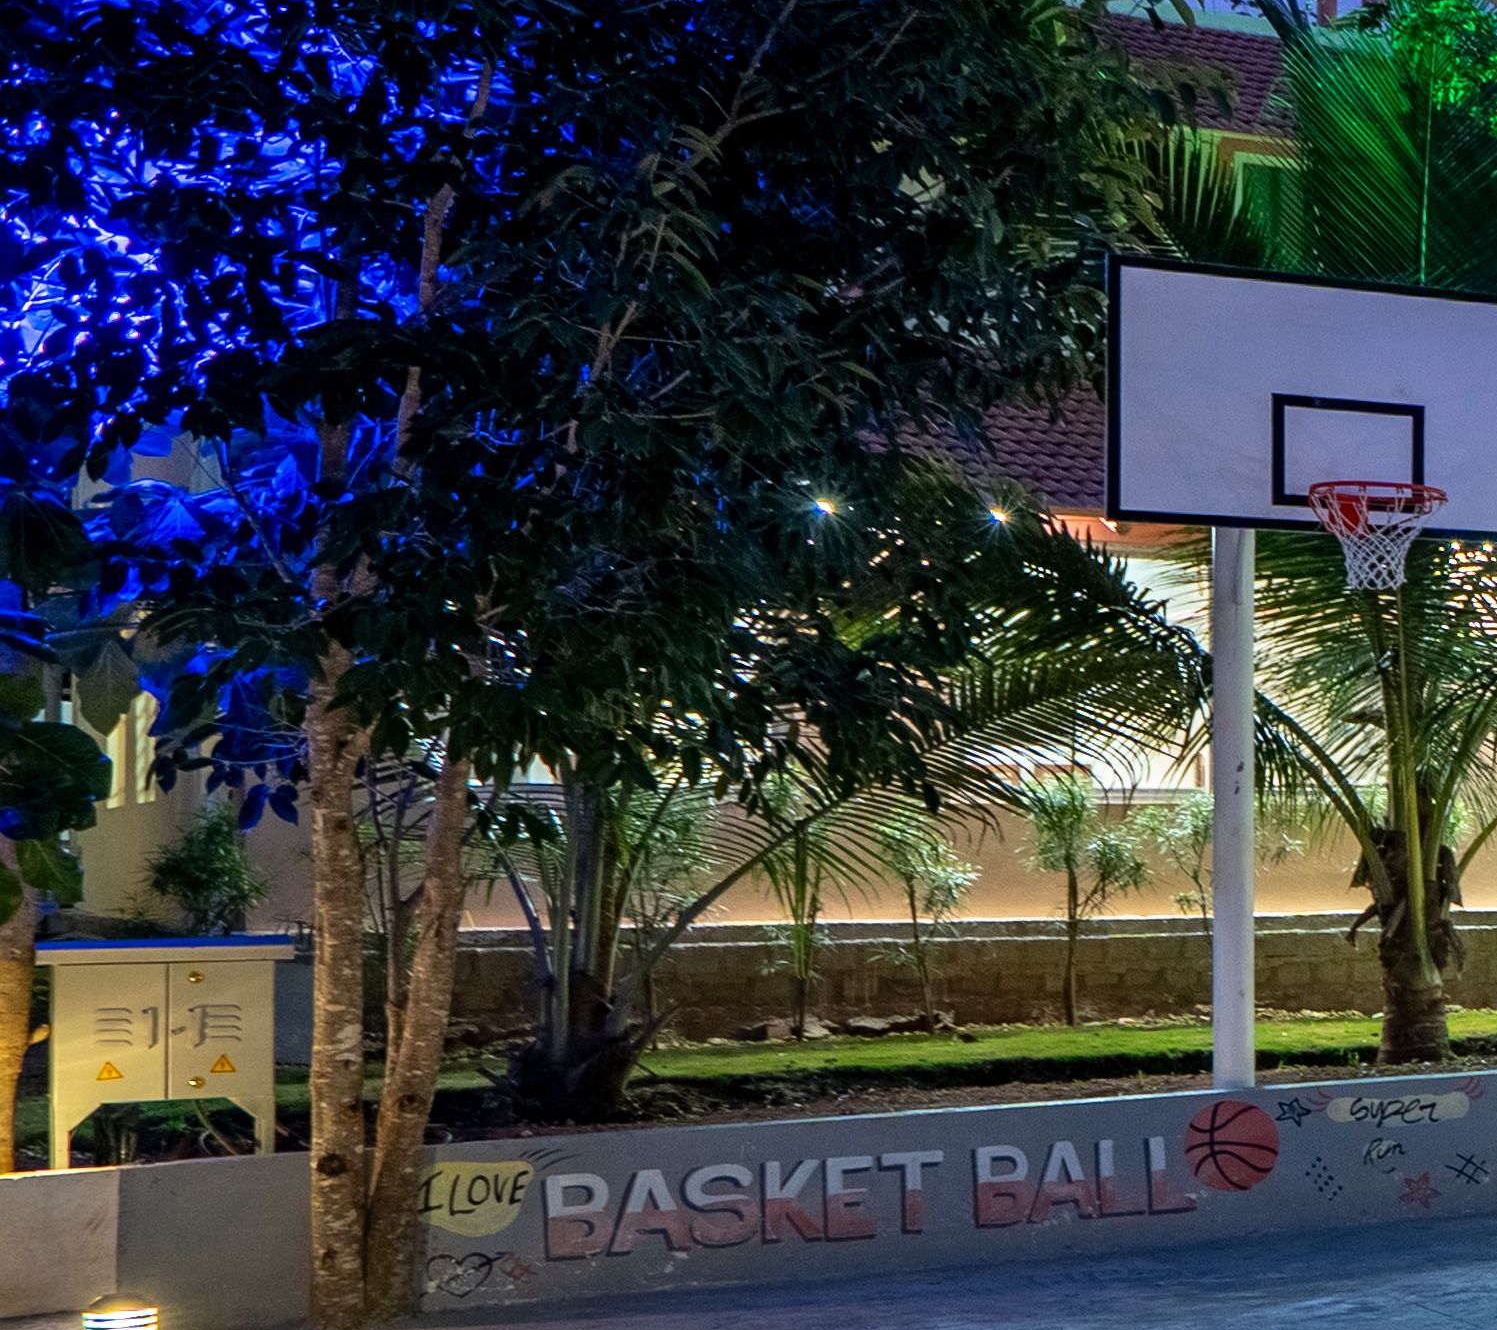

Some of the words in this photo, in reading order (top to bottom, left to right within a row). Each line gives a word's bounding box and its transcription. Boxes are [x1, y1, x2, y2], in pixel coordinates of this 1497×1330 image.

[417, 1172, 443, 1214] I
[449, 1171, 530, 1216] LOVE
[542, 1149, 944, 1262] BASKET
[971, 1136, 1198, 1229] BALL
